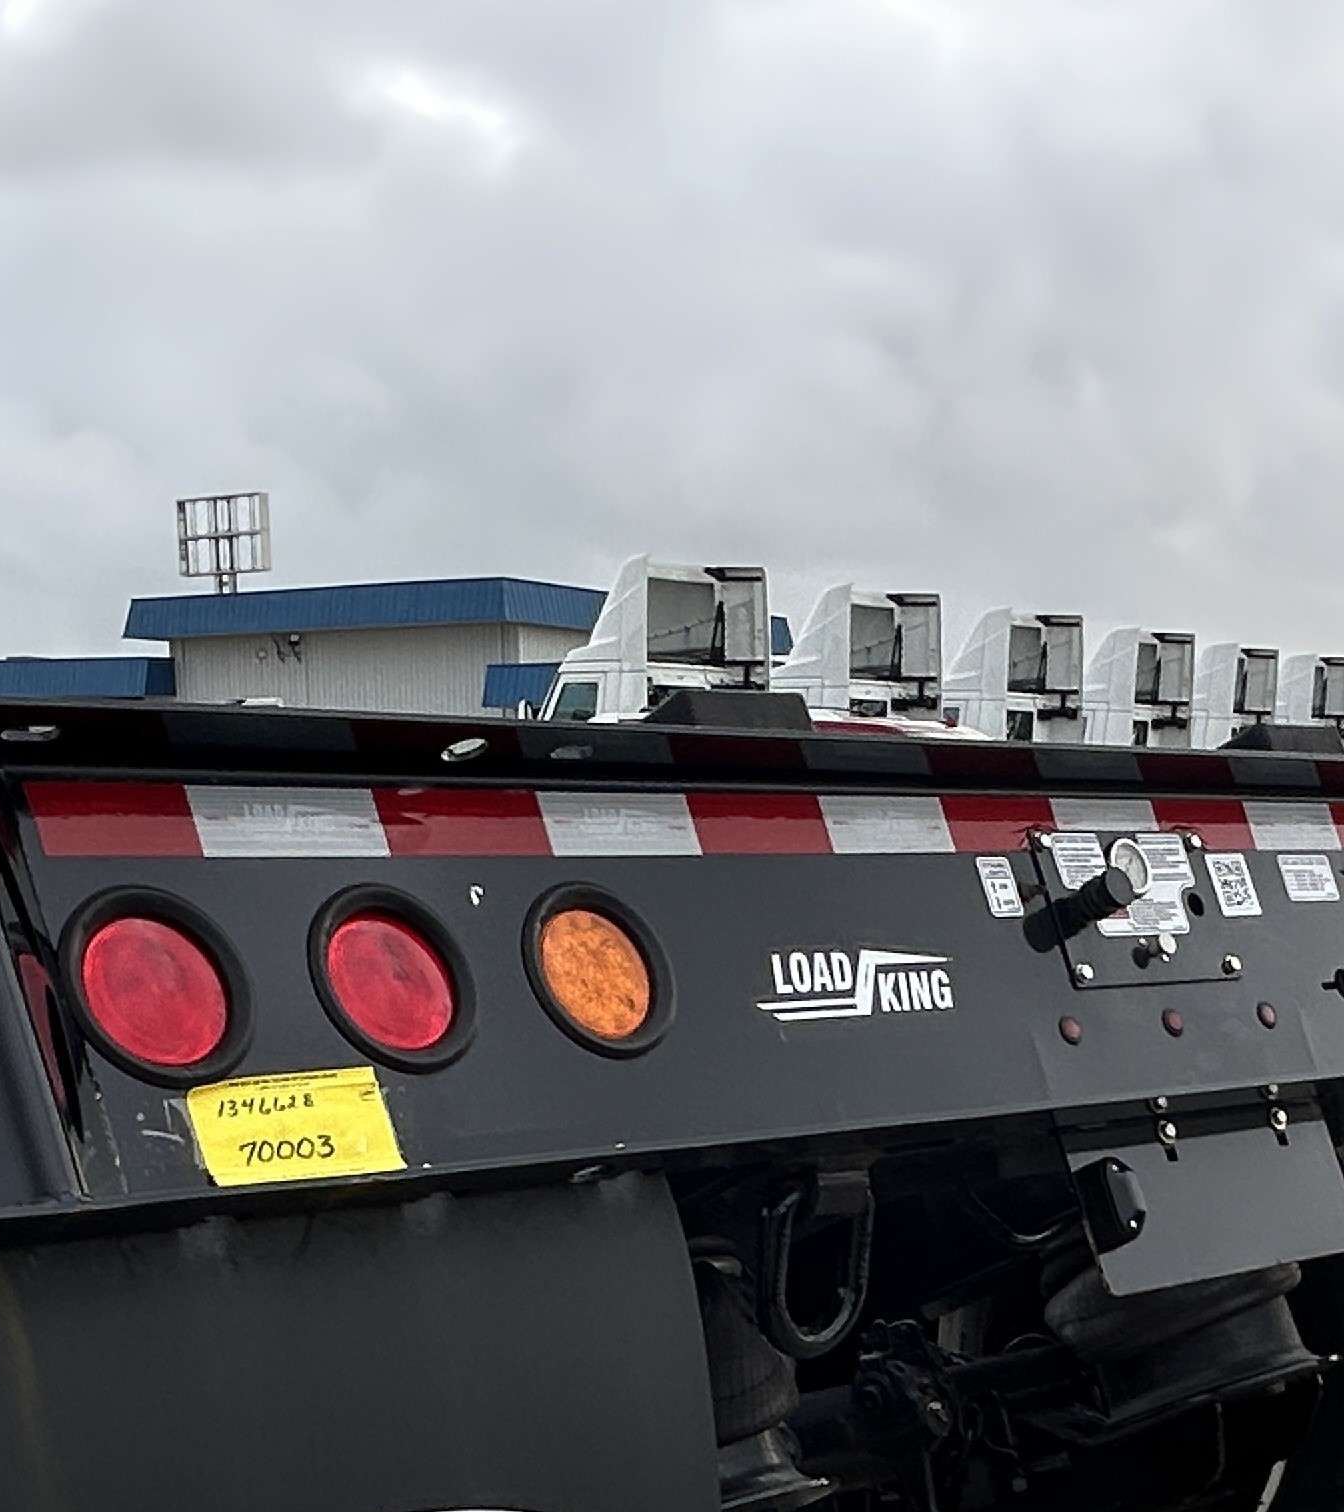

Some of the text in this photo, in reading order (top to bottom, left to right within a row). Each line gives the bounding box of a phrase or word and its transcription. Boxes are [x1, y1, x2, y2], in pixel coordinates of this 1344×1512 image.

[770, 950, 955, 1012] LOAD KING
[238, 1134, 336, 1167] 70003
